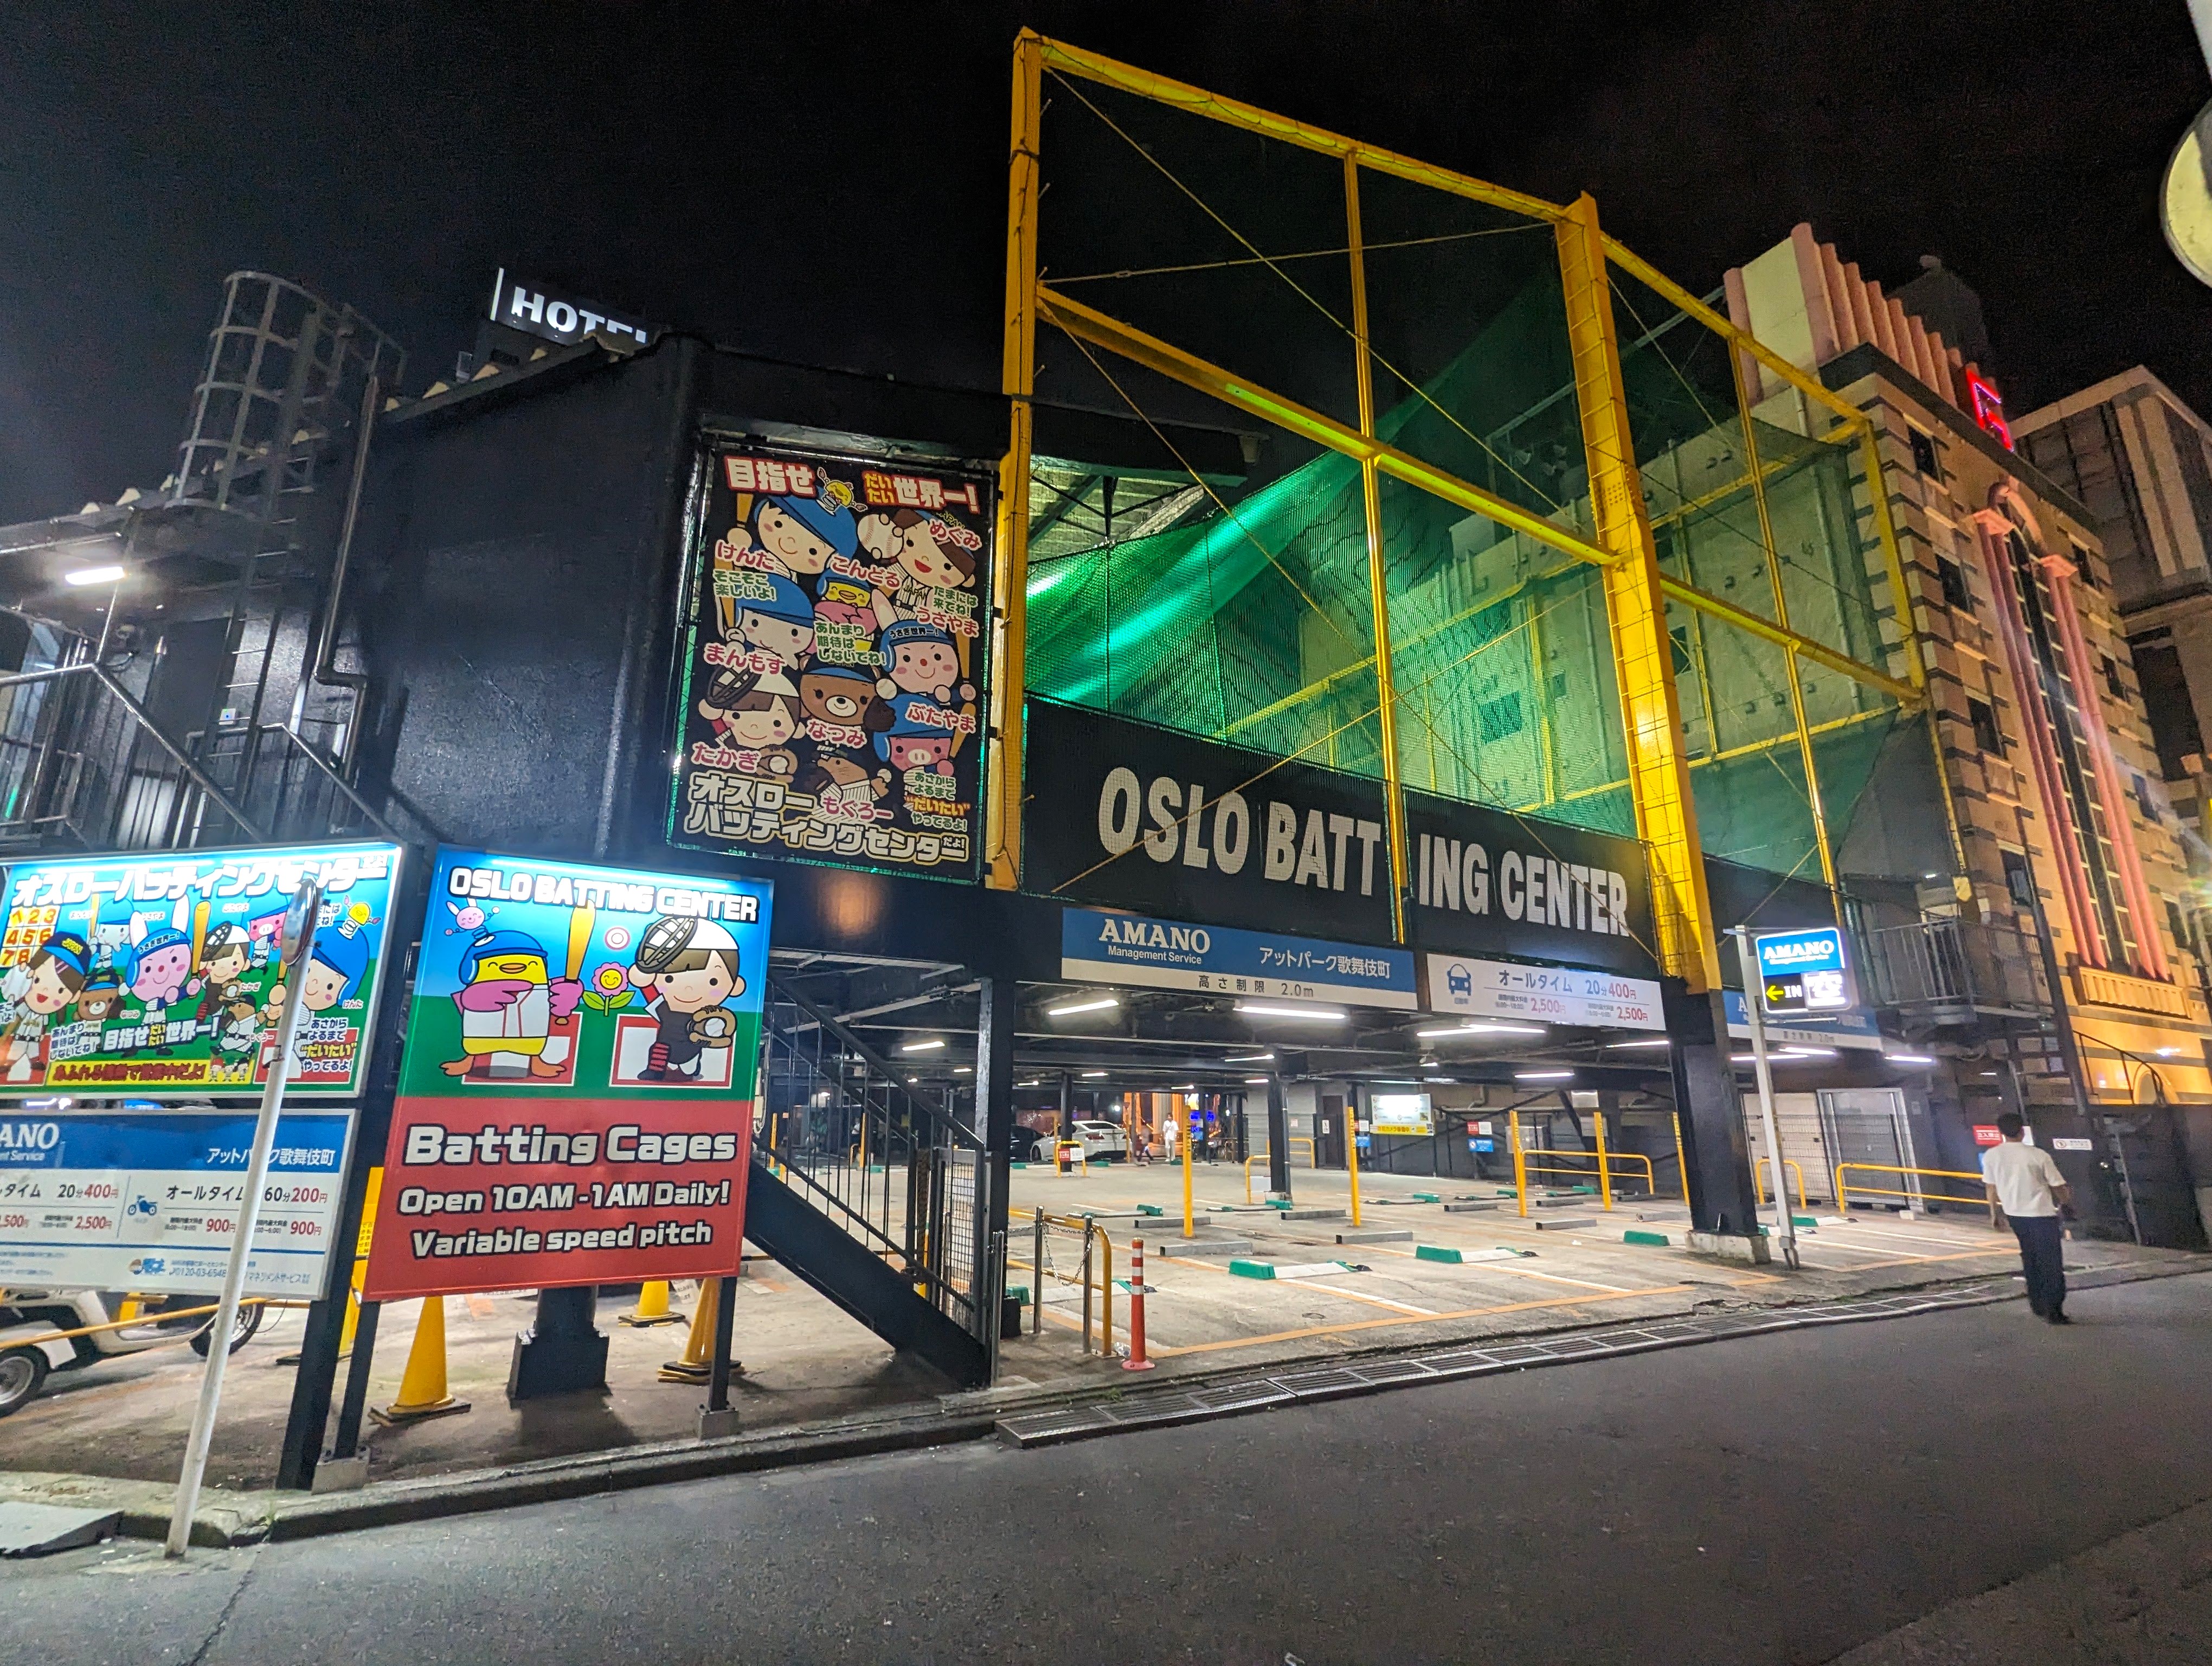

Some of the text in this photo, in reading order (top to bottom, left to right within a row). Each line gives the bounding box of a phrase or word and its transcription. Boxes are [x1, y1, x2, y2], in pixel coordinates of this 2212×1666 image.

[512, 286, 647, 344] HOT
[727, 458, 814, 495] 目指せ
[930, 521, 980, 548] めぐみ
[717, 541, 774, 571] けんた
[714, 571, 767, 586] そこそこ
[832, 556, 901, 588] こんどる
[715, 584, 776, 600] 楽しいよ!
[934, 586, 977, 606] たまには
[933, 598, 971, 616] 来てね!
[815, 622, 864, 637] あんまり
[890, 627, 938, 638] うさぎ世界一!
[917, 607, 978, 636] うさやま
[816, 635, 854, 649] 期待は
[706, 645, 785, 675] まんもす
[818, 650, 886, 665] しないでね!
[907, 703, 974, 732] ぶたやま
[808, 721, 865, 747] なつみ
[694, 744, 759, 771] たかぎ
[692, 774, 813, 810] オスロー
[915, 772, 955, 788] あさから
[822, 796, 892, 819] もぐろー
[689, 803, 965, 861] バッティングセンター
[912, 813, 967, 831] やってるよ!
[1098, 766, 1250, 875] OSLO
[1500, 850, 1630, 938] CENTER
[450, 868, 758, 922] OSLO BATTING CENTER
[1098, 919, 1210, 954] AMANO
[1108, 945, 1202, 964] Management Service
[1763, 940, 1835, 960] AMANO
[1259, 947, 1391, 979] アットパーク歌舞伎町
[1198, 975, 1315, 998] 高さ制限 2.0m
[1499, 970, 1573, 993] オールタイム
[1784, 985, 1803, 998] IN
[311, 1018, 347, 1030] あさから
[103, 1026, 149, 1051] 目指せ
[304, 1060, 352, 1072] やってるよ!
[207, 1148, 335, 1166] アットク歌舞伎町
[406, 1126, 735, 1164] Batting Cages
[400, 1189, 483, 1214] Open
[654, 1181, 731, 1206] Daily!
[413, 1221, 711, 1257] Variable speed pitch
